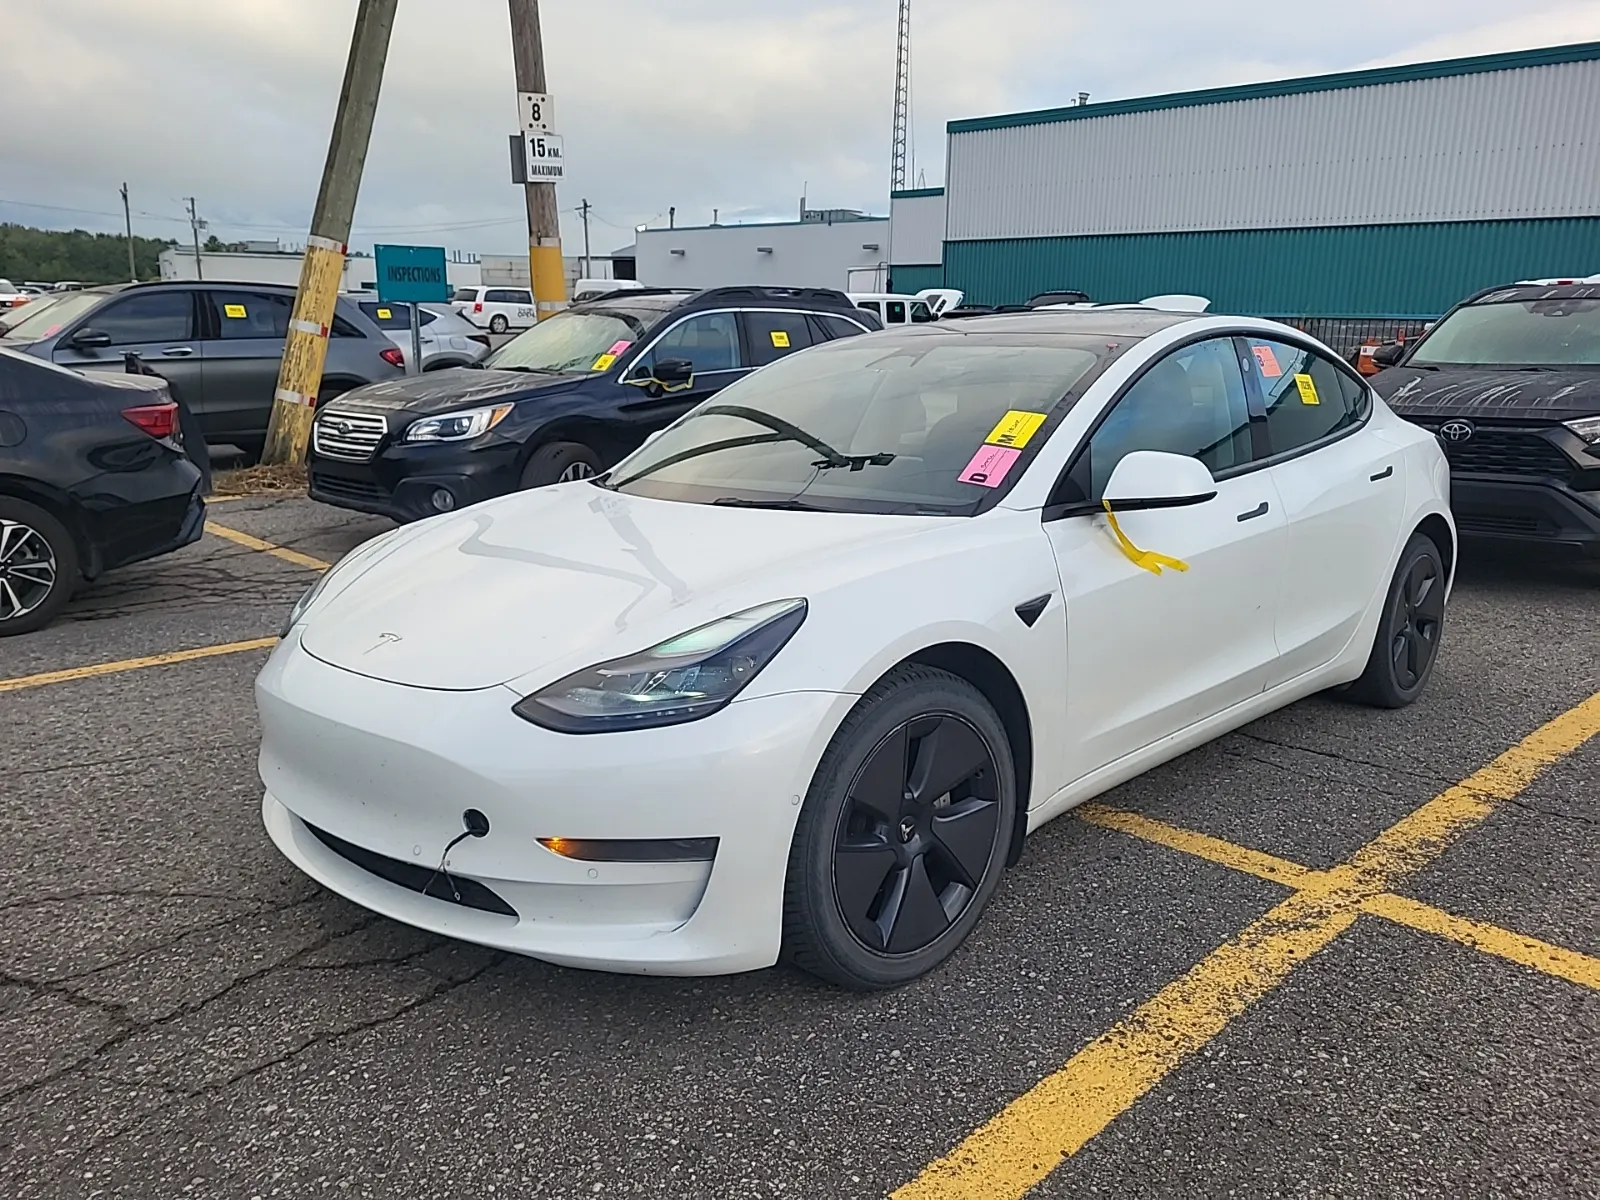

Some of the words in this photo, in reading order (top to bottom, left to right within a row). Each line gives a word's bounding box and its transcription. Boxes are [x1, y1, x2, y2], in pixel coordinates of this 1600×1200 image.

[531, 103, 541, 122] 8
[529, 138, 546, 158] 15
[531, 164, 563, 177] MAXIMUM
[387, 266, 441, 283] INSPECTIONS
[996, 433, 1018, 445] M
[968, 472, 989, 483] D
